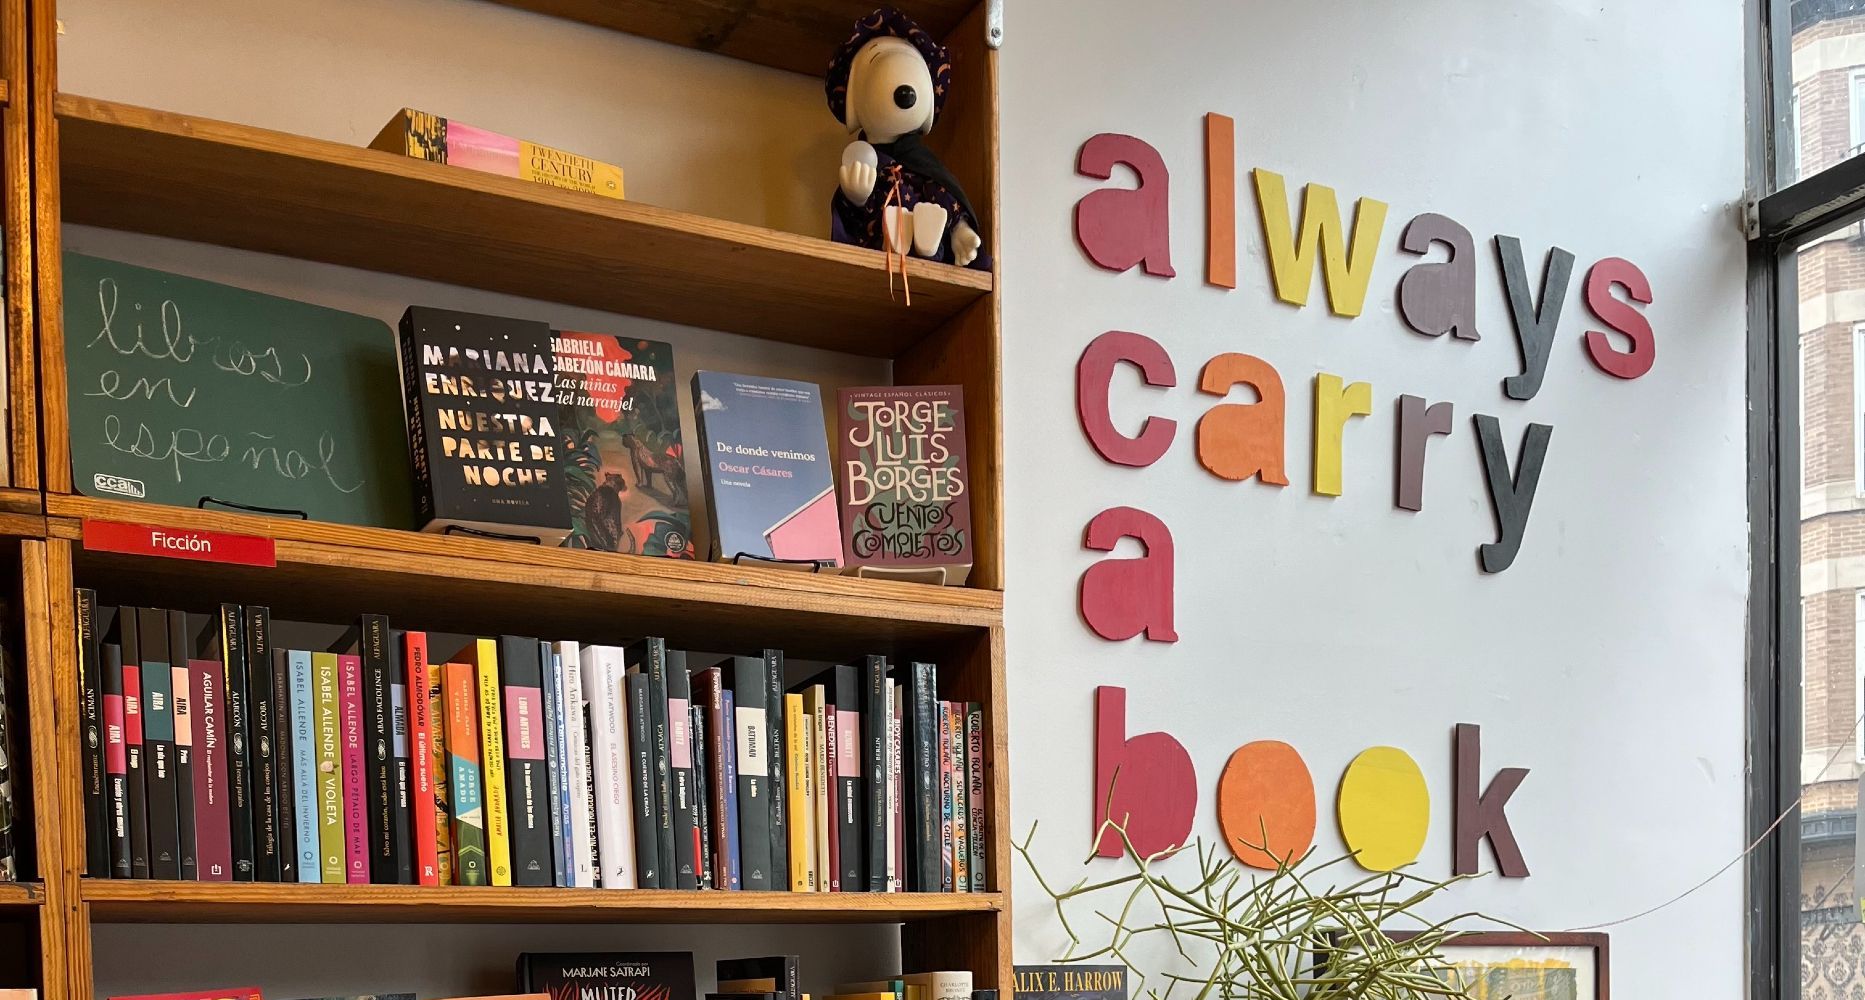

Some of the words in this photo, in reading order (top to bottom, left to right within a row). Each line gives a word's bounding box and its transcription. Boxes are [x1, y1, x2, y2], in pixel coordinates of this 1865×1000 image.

[531, 145, 594, 170] TWENTIETH
[531, 158, 594, 183] CENTURY
[1076, 111, 1656, 400] always
[86, 278, 311, 386] libros
[423, 344, 549, 374] MARIANA
[606, 360, 656, 381] CÁMARA
[84, 370, 196, 407] en
[426, 373, 555, 403] ENRIQUEZ
[579, 378, 617, 393] niñas
[578, 393, 633, 411] naranjel
[438, 408, 555, 437] NUESTRA
[849, 400, 953, 447] JORGE
[104, 415, 365, 493] español
[442, 437, 523, 461] PARTE
[531, 445, 555, 461] DE
[716, 442, 731, 453] De
[735, 444, 767, 456] donde
[770, 448, 816, 461] venimos
[876, 431, 949, 466] LUIS
[1077, 330, 1553, 575] carry
[463, 465, 547, 487] NOCHE
[719, 462, 749, 474] Oscar
[752, 465, 792, 478] Cásares
[847, 461, 964, 505] BORGES
[865, 502, 958, 530] CUENTOS
[152, 532, 211, 552] Ficción
[852, 529, 964, 559] COMPLETOS
[1081, 505, 1178, 644] a
[414, 647, 423, 674] PEDRO
[203, 672, 214, 714] AGUILAR
[321, 666, 332, 704] ISABEL
[346, 661, 357, 696] ISABEL
[127, 696, 137, 714] AIRA
[152, 692, 164, 710] AIRA
[176, 697, 187, 715] AIRA
[415, 677, 425, 727] ALMODÓVAR
[109, 724, 121, 744] AIRA
[205, 716, 217, 748] CAMÍN
[323, 707, 334, 757] ALLENDE
[347, 702, 358, 748] ALLENDE
[970, 713, 981, 752] ROBERTO
[418, 740, 427, 765] último
[419, 767, 429, 791] sueño
[972, 757, 983, 795] BOLAÑO
[1094, 685, 1531, 878] book
[325, 778, 337, 825] VIOLETA
[562, 968, 608, 978] MARJANE
[610, 966, 650, 978] SATRAPI
[1013, 972, 1044, 992] ALIX
[1049, 972, 1060, 992] E.
[1065, 971, 1123, 992] HARROW
